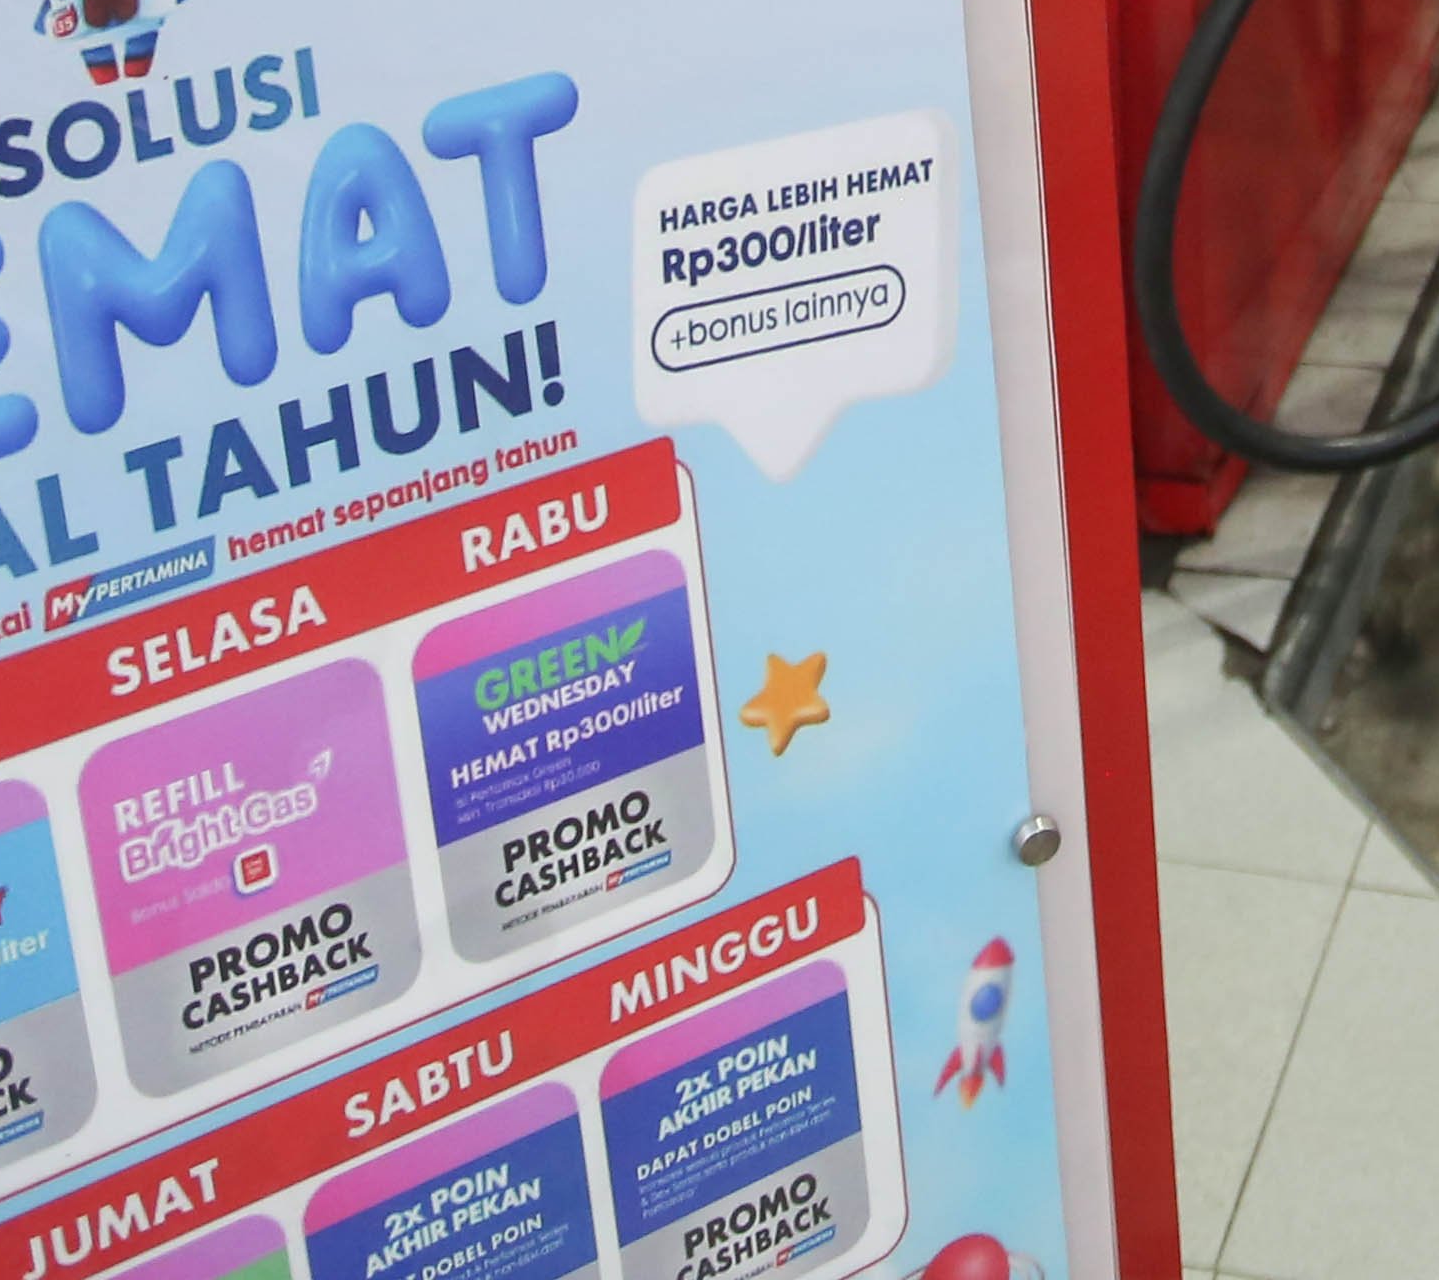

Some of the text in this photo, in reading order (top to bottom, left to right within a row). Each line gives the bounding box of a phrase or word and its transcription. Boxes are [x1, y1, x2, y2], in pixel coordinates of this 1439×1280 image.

[660, 158, 933, 234] HARGA LEBIH HEMAT
[662, 212, 881, 287] Rp300/liter
[670, 282, 889, 351] +bonus lainnya
[124, 321, 566, 532] TAHUN!
[49, 548, 211, 620] MyPERTAMINA
[227, 507, 327, 562] hemat
[333, 457, 489, 527] sepanjang
[495, 428, 578, 473] tahun
[107, 584, 329, 697] SELASA
[461, 484, 610, 574] RABU
[473, 622, 623, 712] GREEN
[482, 660, 637, 736] WEDNESDAY
[449, 684, 685, 790] HEMAT Rp300/liter
[113, 760, 246, 835] REFILL
[119, 803, 245, 884] Bright
[240, 782, 318, 835] Gas
[502, 790, 651, 875] PROMO
[494, 817, 669, 909] CASHBACK
[181, 931, 373, 1031] CASHBACK
[188, 902, 354, 995] PROMO
[21, 895, 822, 1280] JUMAT SABTU MINGGU
[657, 1047, 818, 1142] AKHIR PEKAN
[674, 1033, 790, 1106] 2x POIN
[635, 1084, 813, 1182] DAPAT DOBEL POIN
[365, 1218, 450, 1280] AKHIR
[451, 1175, 542, 1234] PEKAN
[383, 1161, 510, 1242] 2x POIN
[420, 1243, 488, 1280] DOBEL
[490, 1212, 544, 1252] POIN
[675, 1196, 833, 1280] CASHBACK
[683, 1172, 818, 1261] PROMO
